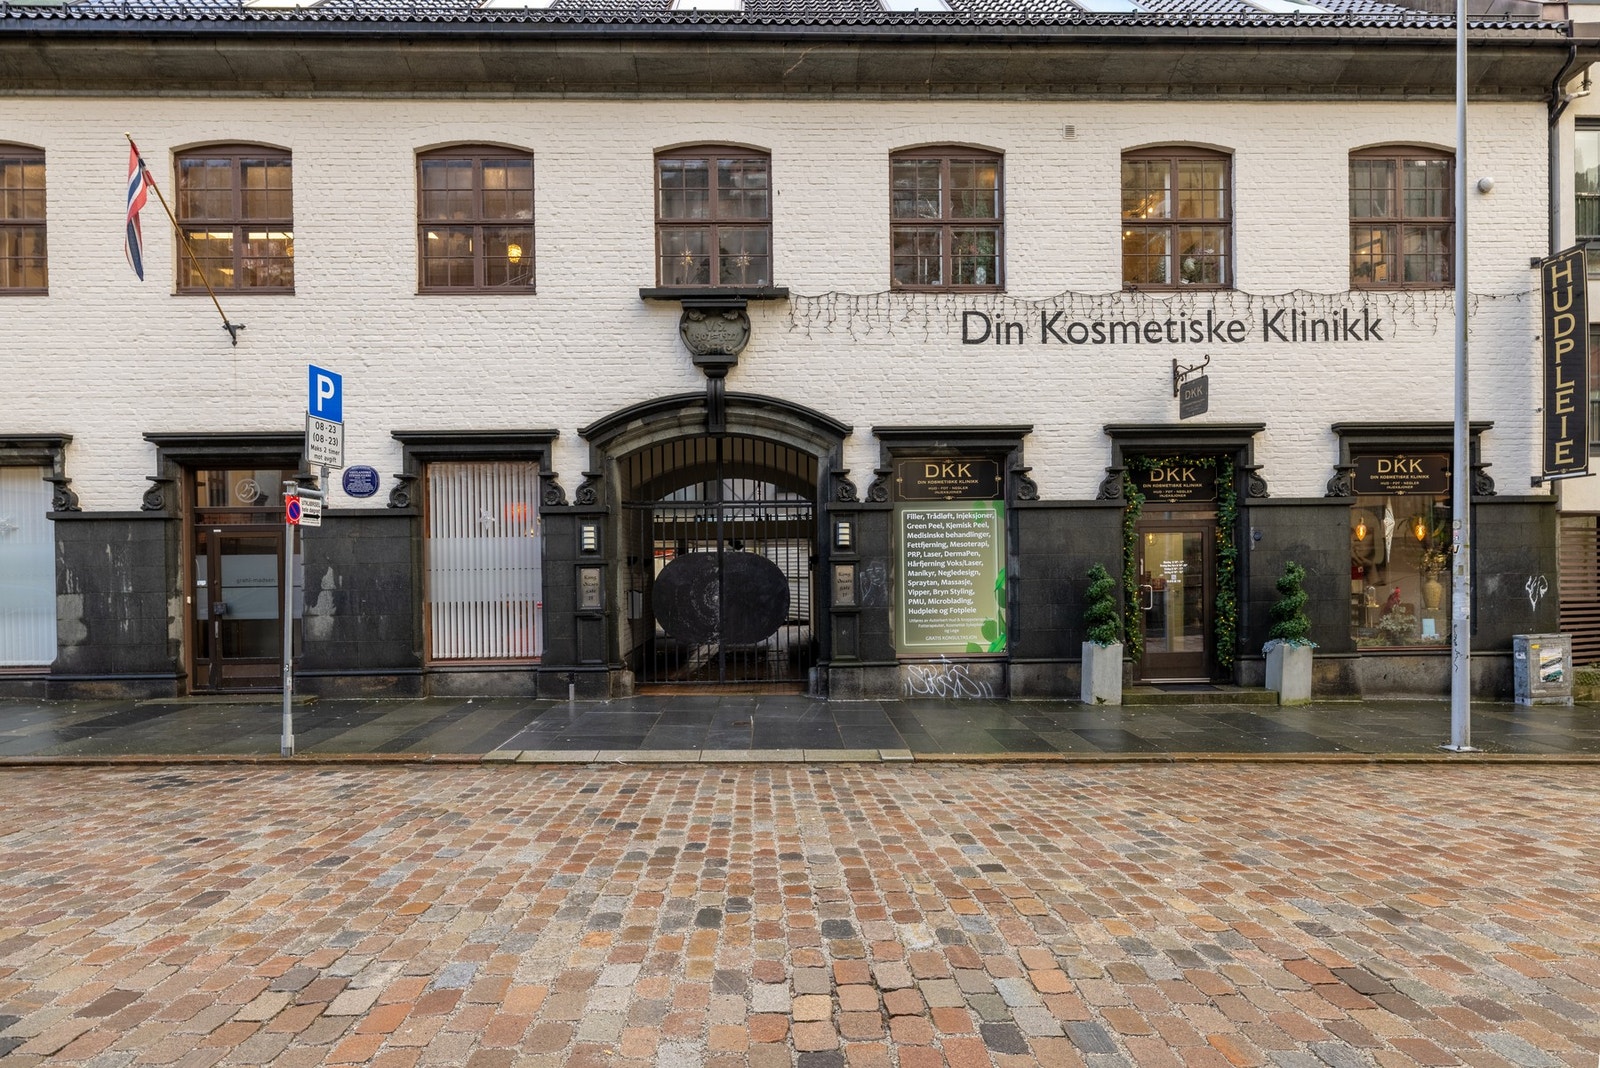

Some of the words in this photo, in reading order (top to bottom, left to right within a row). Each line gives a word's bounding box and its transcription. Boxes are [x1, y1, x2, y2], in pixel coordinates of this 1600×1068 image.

[962, 310, 1024, 344] Din
[1041, 309, 1246, 344] Kosmetiske
[1263, 308, 1384, 342] Klinikk
[1551, 259, 1576, 465] HUDPLEIE
[317, 373, 335, 411] P
[1184, 385, 1203, 400] DKK
[310, 444, 322, 453] Maks
[328, 447, 340, 456] timer
[324, 455, 337, 464] avgift
[1378, 459, 1423, 473] DKK
[925, 463, 972, 478] DKK
[1150, 467, 1196, 482] DKK
[240, 482, 256, 498] 25
[926, 512, 955, 520] Trådløft,
[956, 512, 995, 520] Injeksjoner,
[946, 522, 972, 530] Kjemisk
[946, 531, 991, 539] behandlinger,
[907, 560, 946, 568] Hårfjerning
[938, 569, 981, 577] Negledesign,
[950, 588, 975, 596] Styling,
